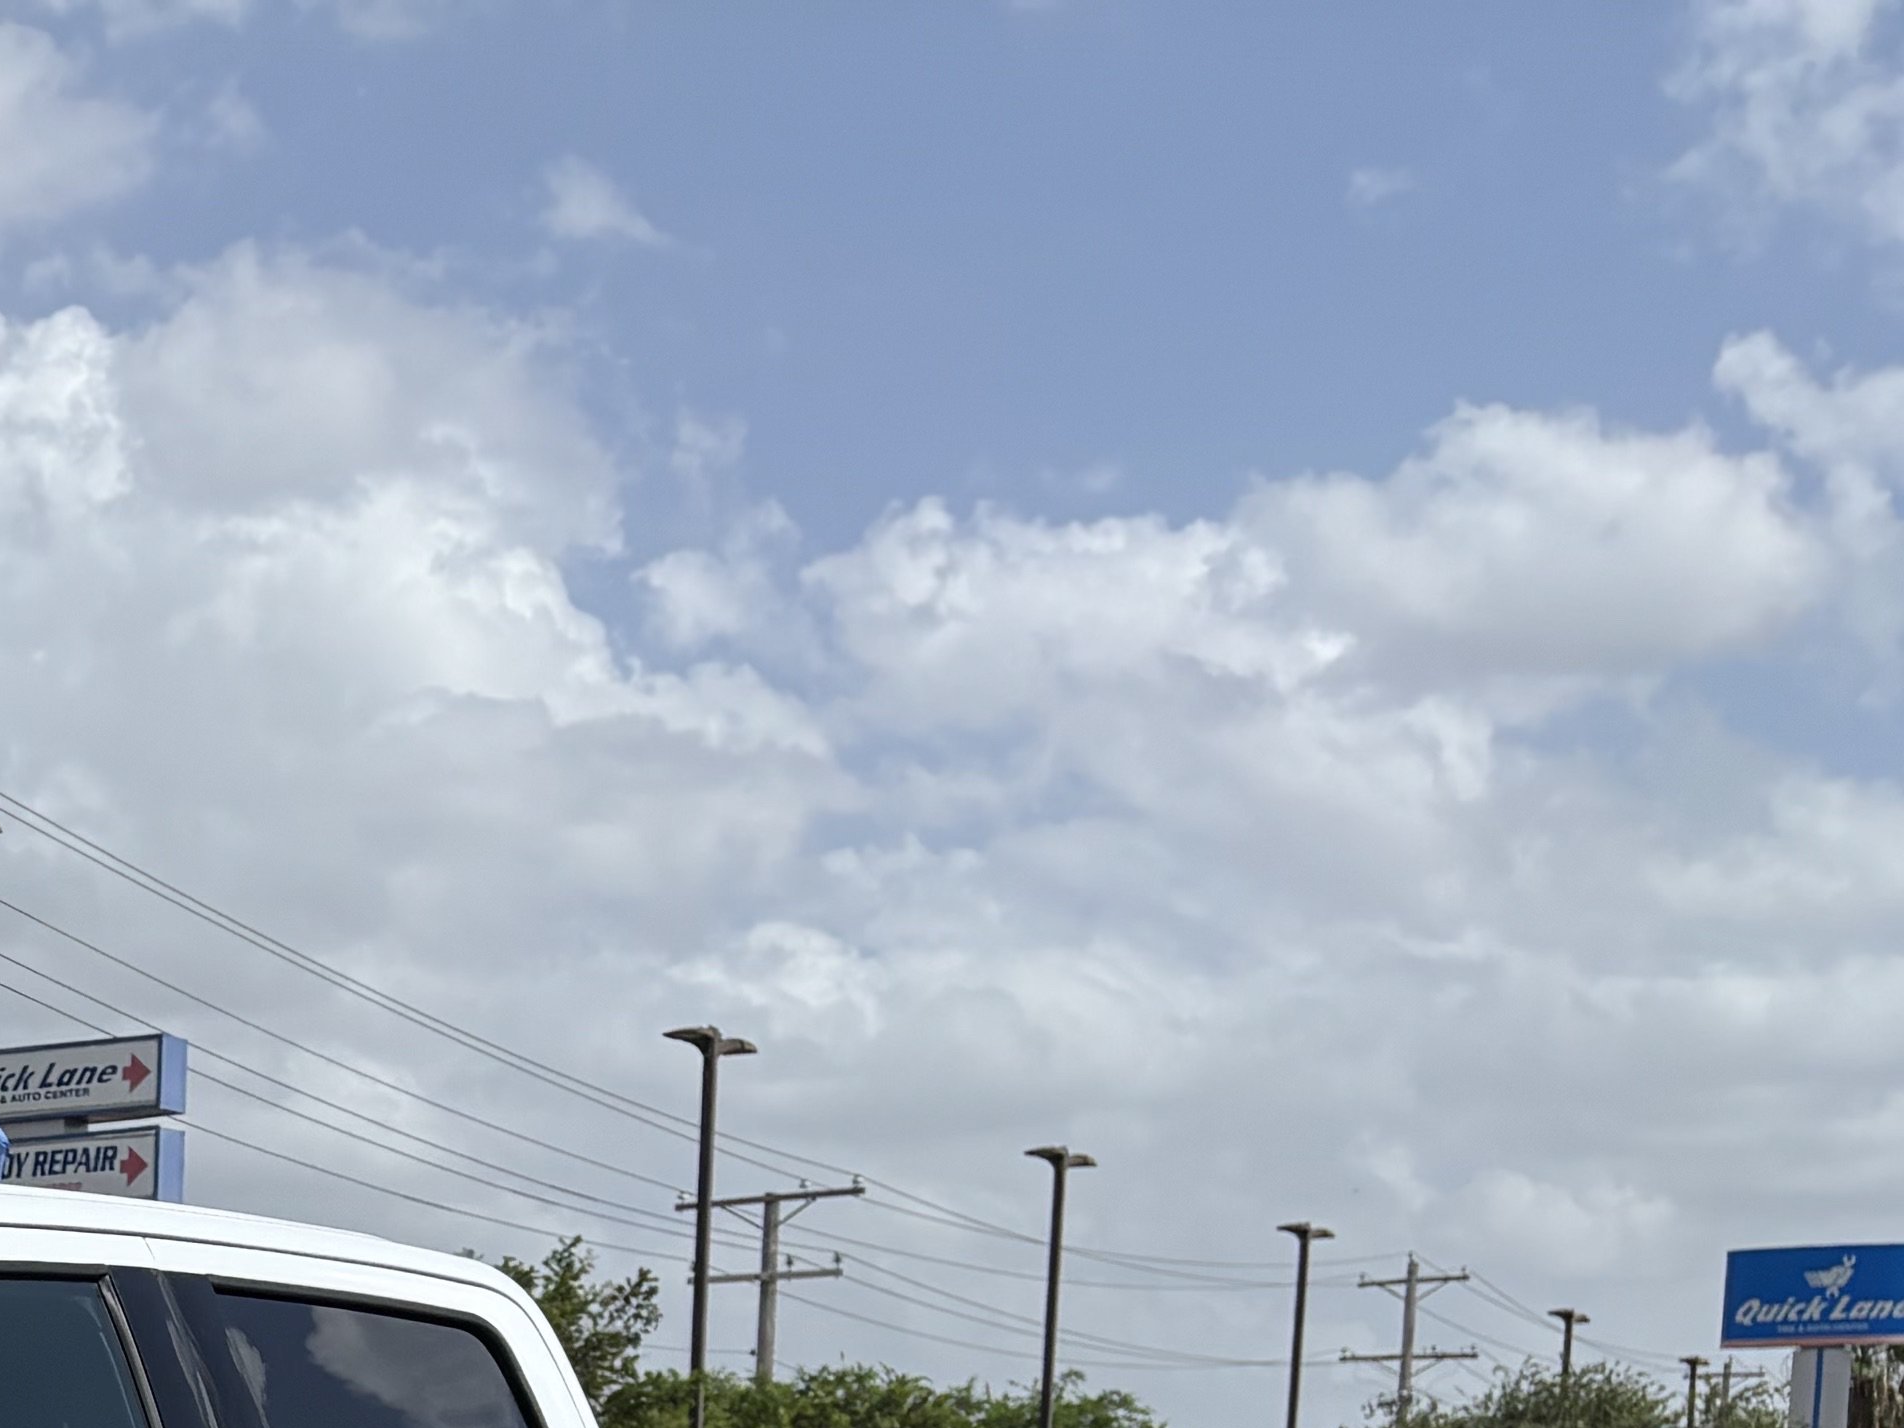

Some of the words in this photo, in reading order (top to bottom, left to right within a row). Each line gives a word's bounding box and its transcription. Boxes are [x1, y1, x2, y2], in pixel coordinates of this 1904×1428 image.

[39, 1063, 118, 1089] Lane
[10, 1092, 42, 1104] AUTO
[44, 1087, 90, 1101] CENTER
[32, 1146, 118, 1178] REPAIR
[1735, 1295, 1829, 1327] Quick
